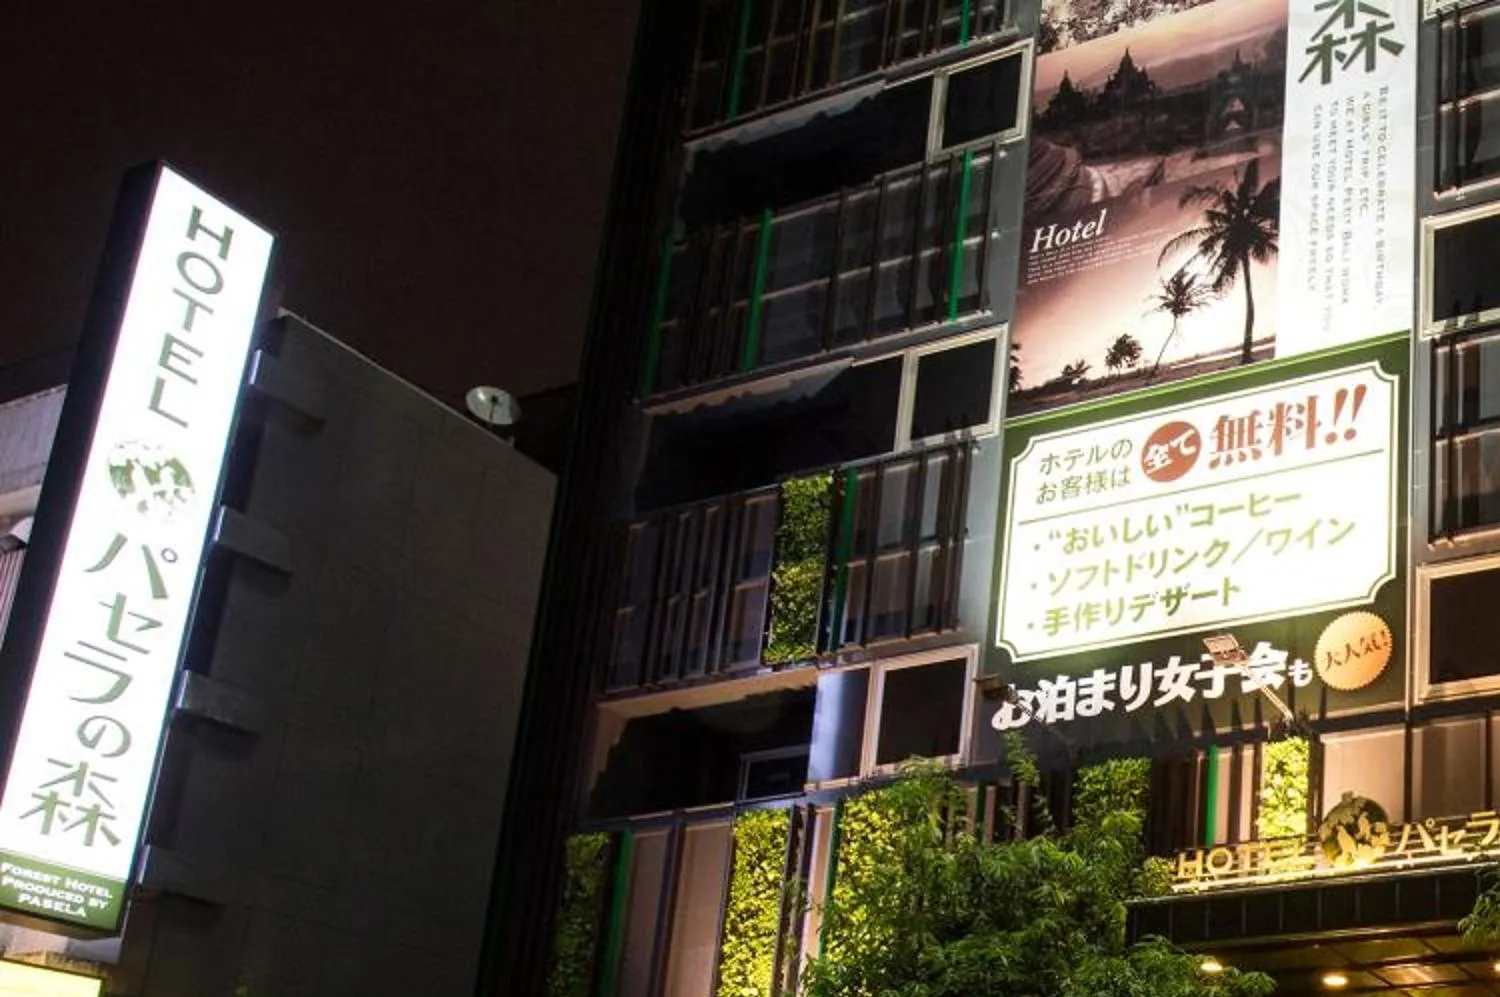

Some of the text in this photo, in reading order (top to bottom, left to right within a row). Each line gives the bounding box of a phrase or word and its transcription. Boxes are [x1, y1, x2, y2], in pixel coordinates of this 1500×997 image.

[1344, 139, 1354, 181] HOTEL
[1030, 208, 1108, 253] Hotel
[147, 204, 234, 428] HOTEL
[1039, 437, 1133, 476] ホテルの
[1144, 430, 1198, 473] 全て
[1036, 467, 1132, 505] お客様は
[18, 532, 178, 847] パセラの森
[1177, 838, 1316, 879] HOTEL
[18, 893, 87, 917] PASELA
[65, 877, 113, 899] HOTEL
